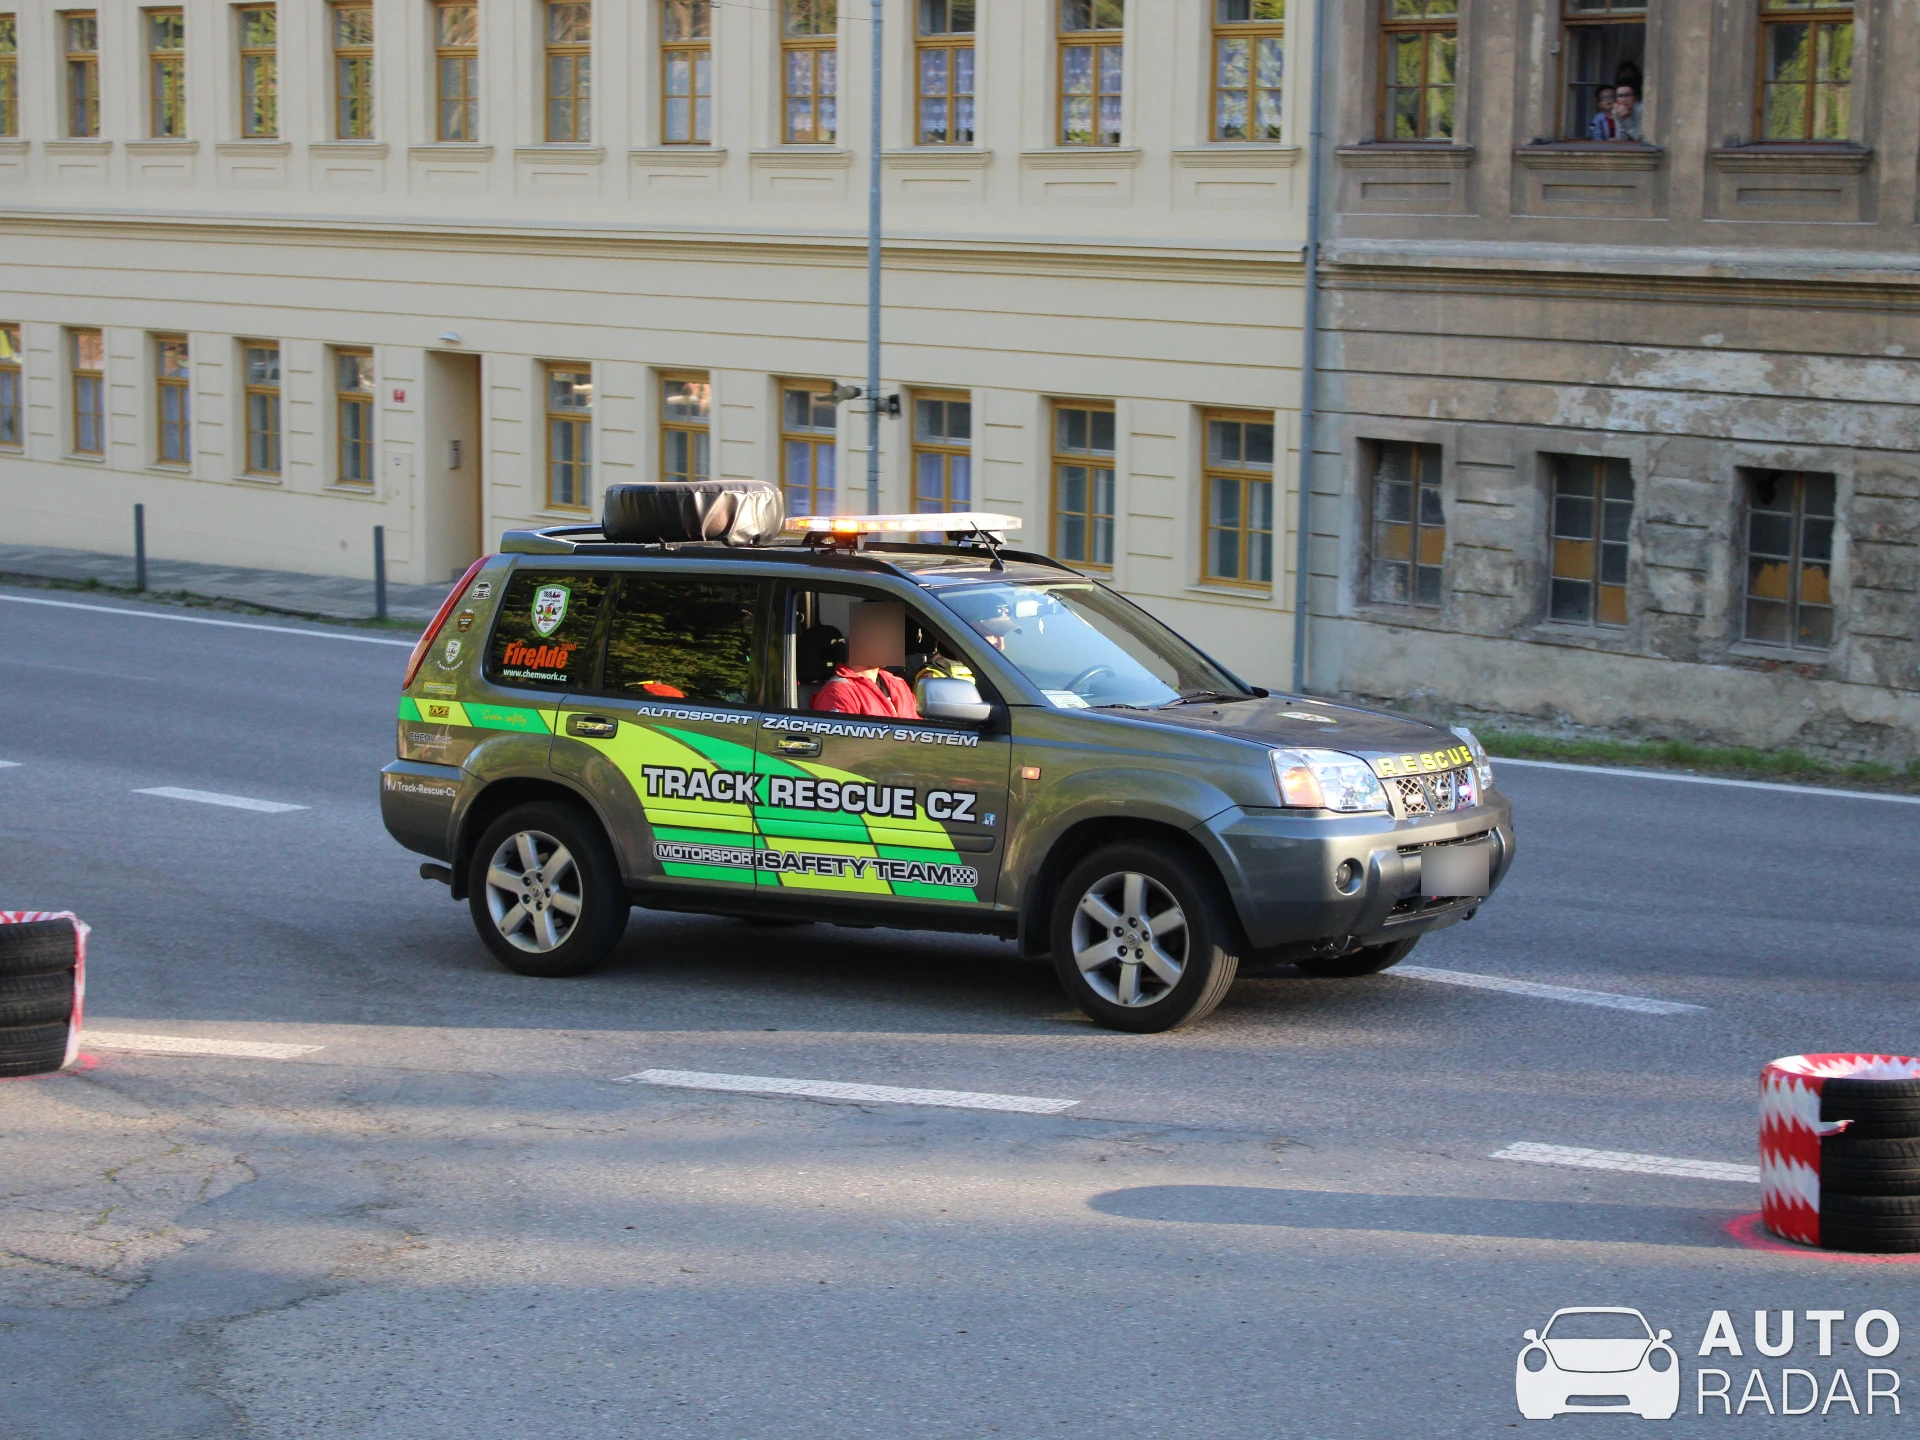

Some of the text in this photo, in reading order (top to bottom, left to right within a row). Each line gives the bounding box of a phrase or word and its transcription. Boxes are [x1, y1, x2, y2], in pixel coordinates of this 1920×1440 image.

[503, 641, 569, 669] FireAde
[503, 669, 567, 681] www.chemwork.cz
[637, 706, 752, 725] AUTOSPORT
[762, 715, 979, 748] ZÁCHRANNÝ SYSTÉM
[1376, 745, 1473, 776] RESCUE
[643, 766, 977, 823] TRACK RESCUE CZ
[657, 844, 952, 885] MOTORSPORT SAFETY TEAM
